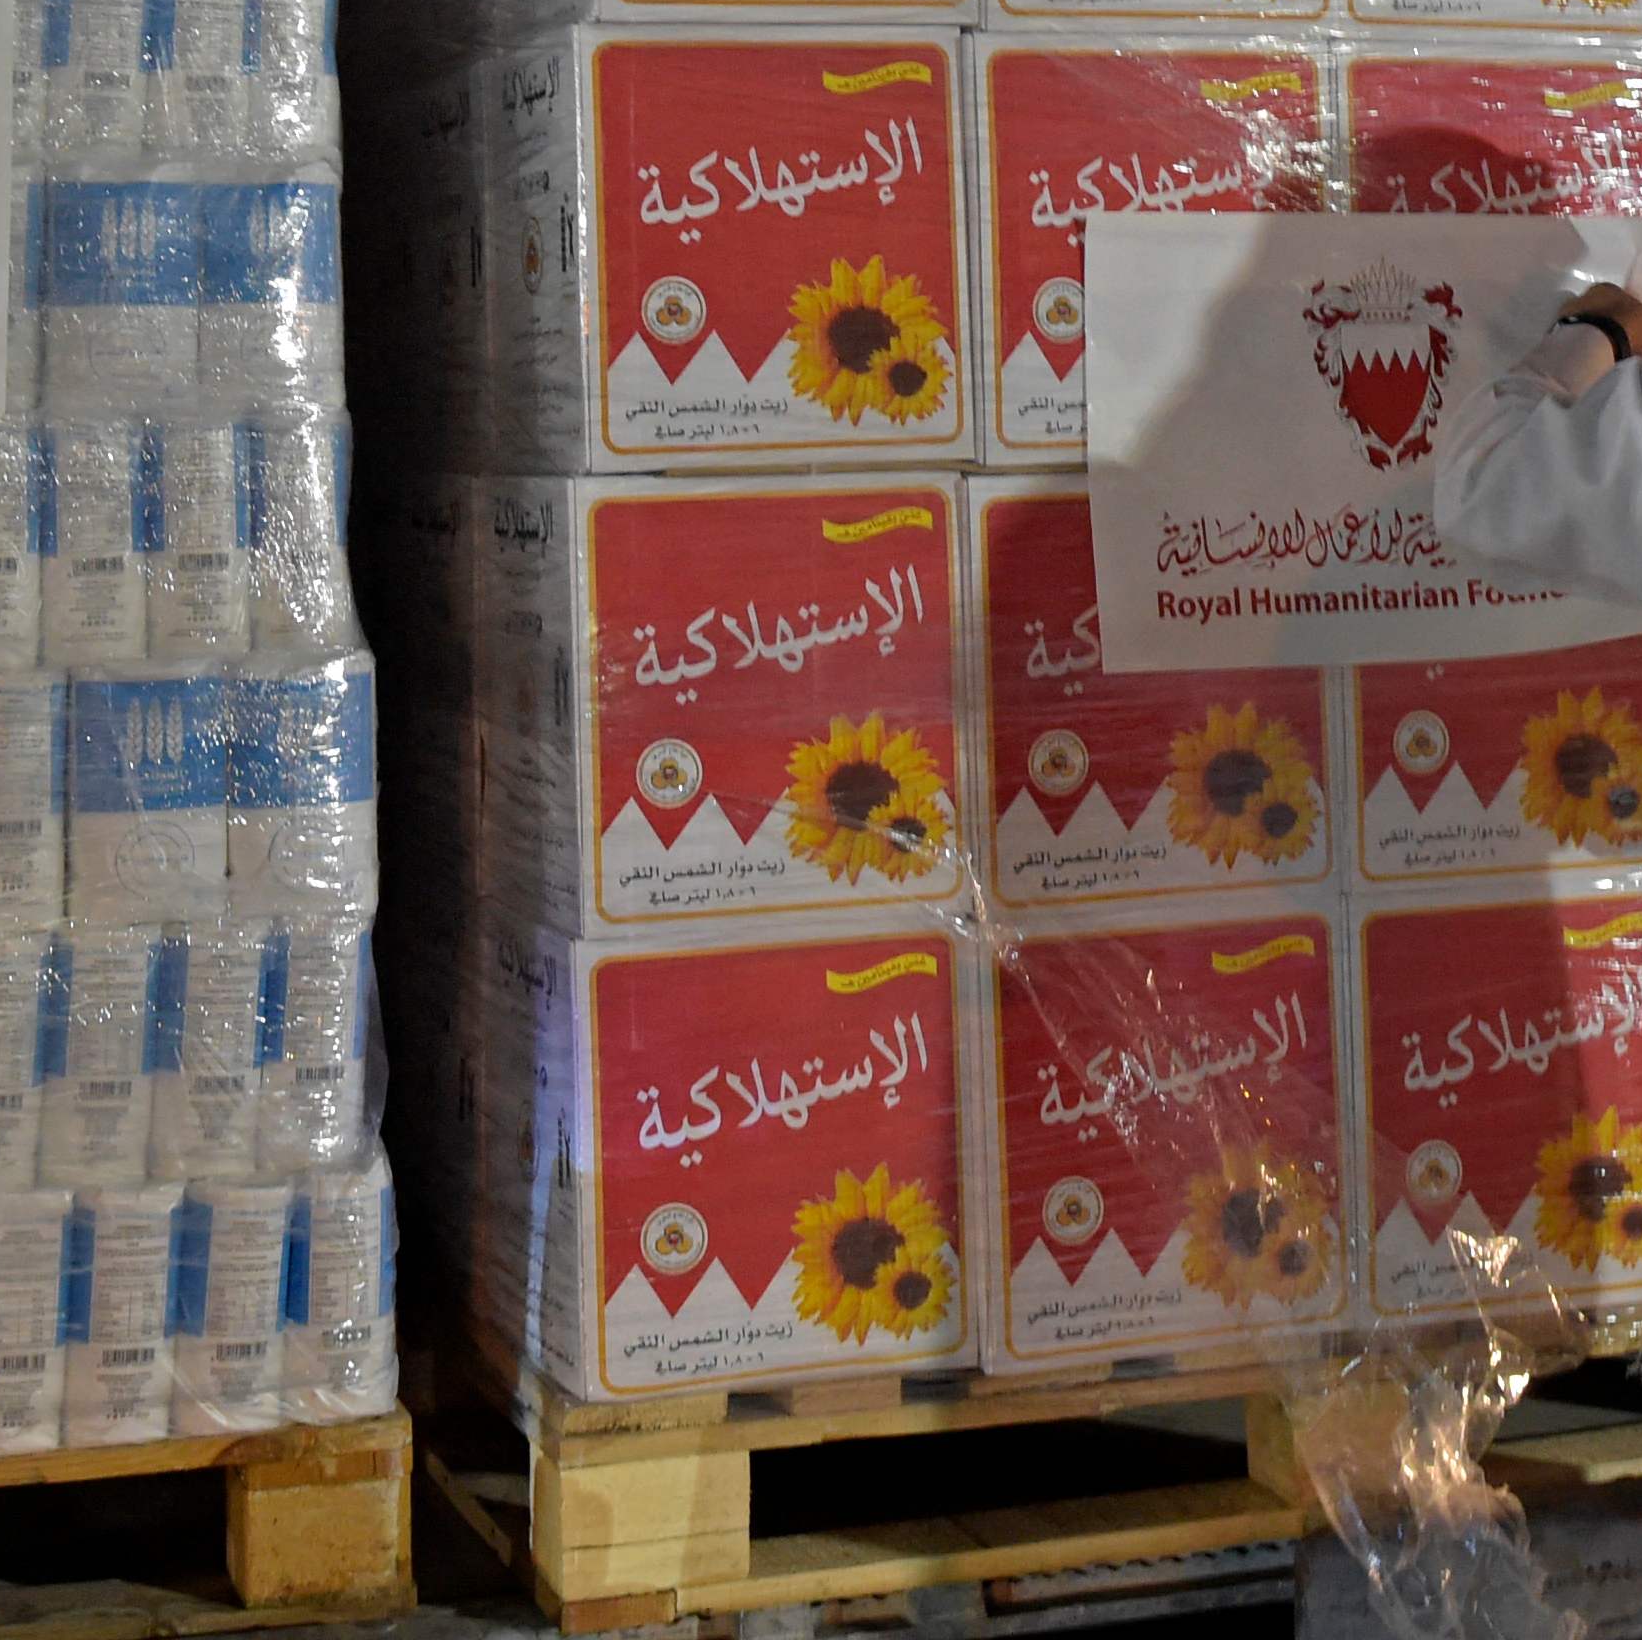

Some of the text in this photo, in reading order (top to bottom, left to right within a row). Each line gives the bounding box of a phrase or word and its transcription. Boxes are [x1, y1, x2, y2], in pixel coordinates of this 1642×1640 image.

[638, 115, 924, 244] الإستهلاكية
[1029, 152, 1277, 247] لإستهلاكية
[625, 400, 664, 421] النقي
[668, 399, 725, 417] الشمس
[760, 398, 789, 415] زيت
[1018, 397, 1054, 416] النقي
[1157, 587, 1240, 625] Royal
[1251, 581, 1458, 614] Humanitarian
[633, 564, 924, 706] الإستهلاكية
[619, 866, 659, 887] النقي
[663, 862, 721, 882] الشمس
[757, 857, 785, 874] زيت
[1037, 992, 1309, 1142] الإستهلاكية
[638, 1012, 929, 1169] الإستهلاكية
[669, 1328, 728, 1351] الشمس
[765, 1321, 793, 1339] زيت
[623, 1334, 664, 1357] النقي
